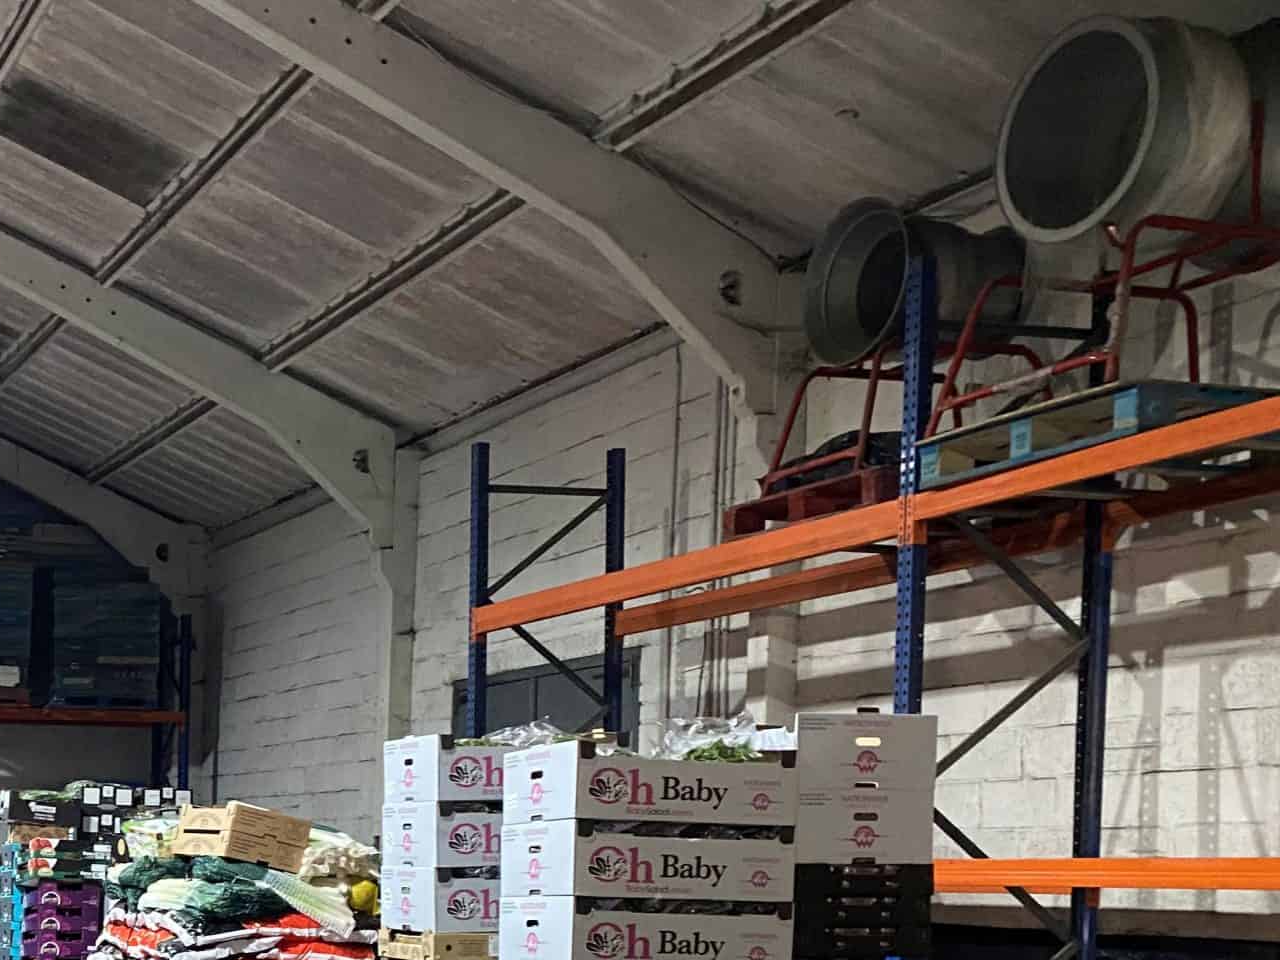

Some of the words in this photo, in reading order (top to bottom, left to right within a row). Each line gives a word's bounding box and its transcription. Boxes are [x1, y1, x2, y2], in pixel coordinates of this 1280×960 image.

[589, 767, 656, 806] Oh
[661, 776, 729, 810] Baby
[588, 846, 655, 884] Oh
[660, 854, 728, 887] Baby
[586, 922, 653, 960] Oh
